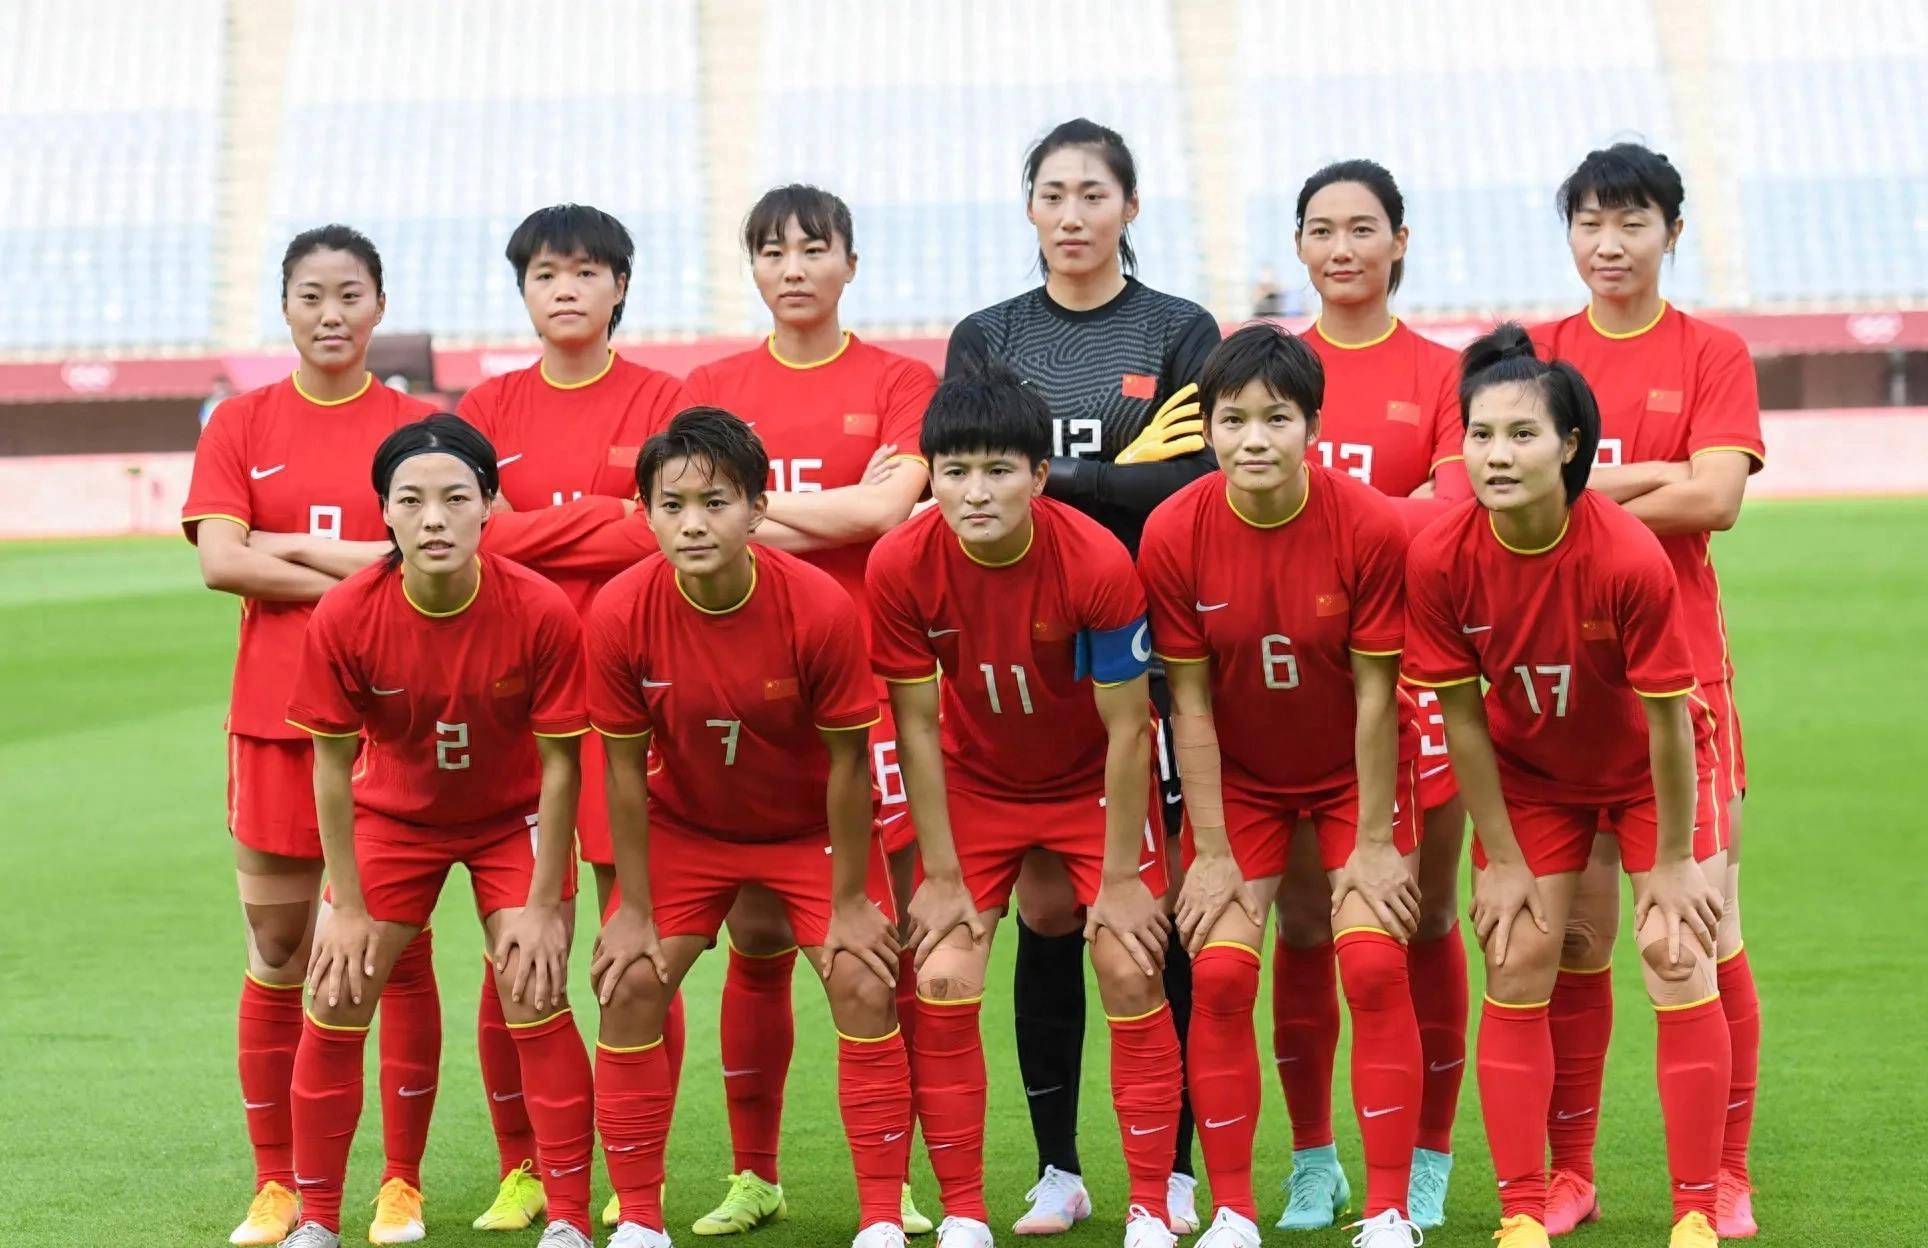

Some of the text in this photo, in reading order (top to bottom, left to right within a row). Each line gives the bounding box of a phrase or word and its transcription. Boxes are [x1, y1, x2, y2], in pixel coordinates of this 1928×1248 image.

[1052, 418, 1102, 458] 12
[1261, 633, 1300, 689] 6
[979, 663, 1034, 715] 11
[1513, 664, 1572, 717] 17
[436, 720, 470, 770] 2
[705, 719, 741, 766] 7
